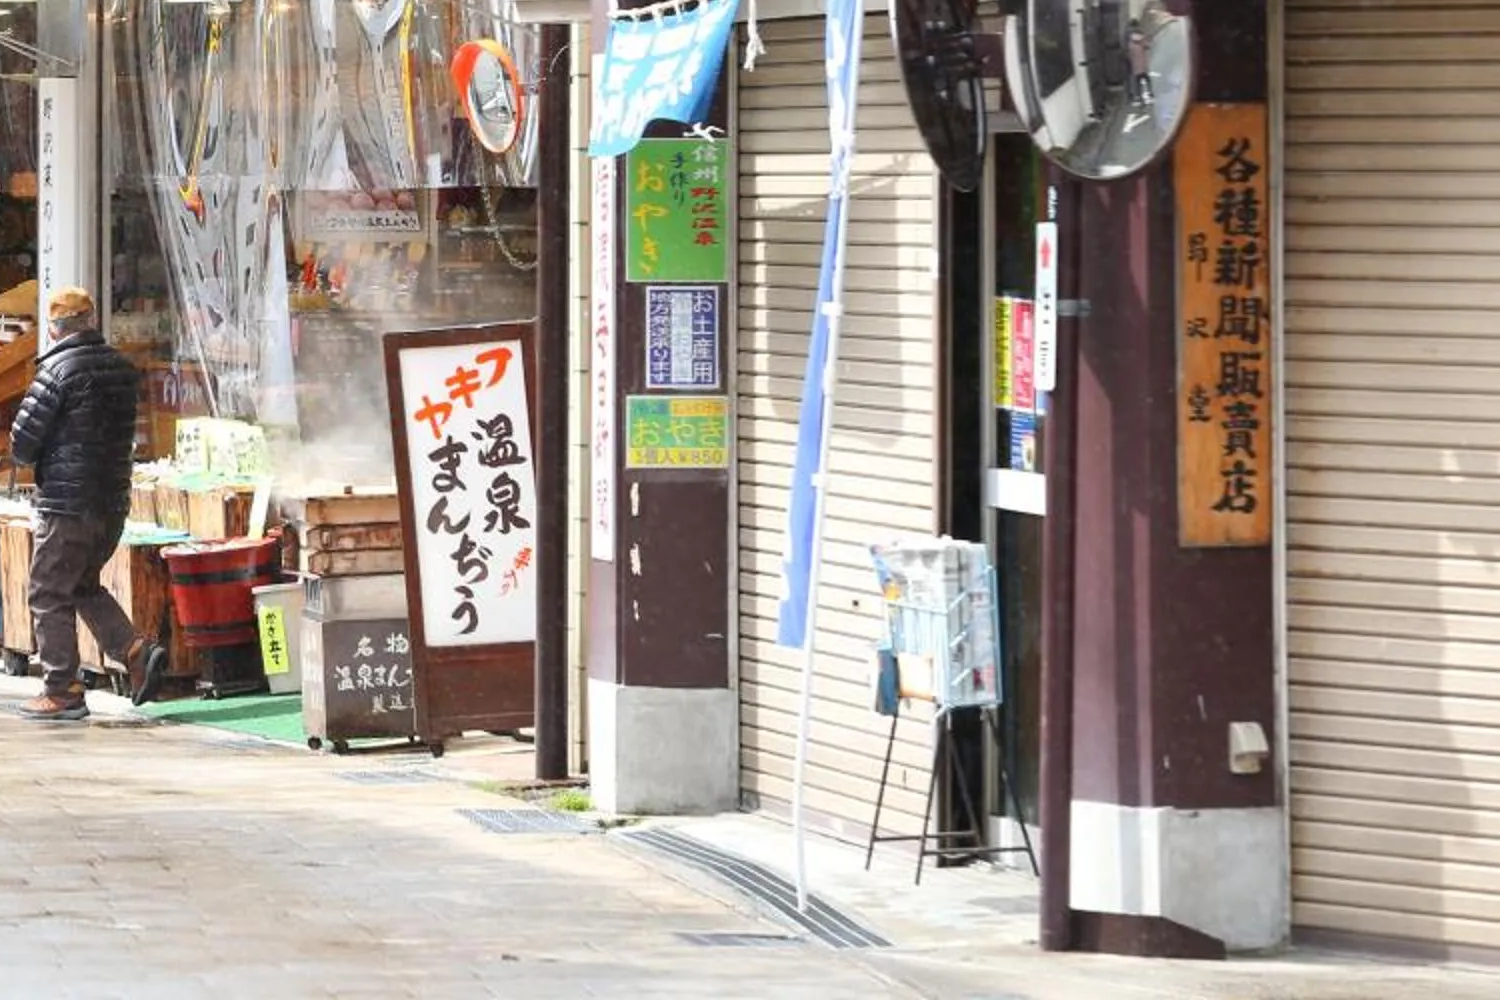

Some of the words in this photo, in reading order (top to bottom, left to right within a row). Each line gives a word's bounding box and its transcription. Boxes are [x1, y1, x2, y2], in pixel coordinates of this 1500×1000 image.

[632, 160, 669, 275] おやき
[692, 292, 714, 383] お土産用
[414, 348, 512, 439] フキヤ
[632, 418, 722, 446] おやき
[471, 414, 531, 535] 温泉
[426, 435, 493, 635] まんぢう
